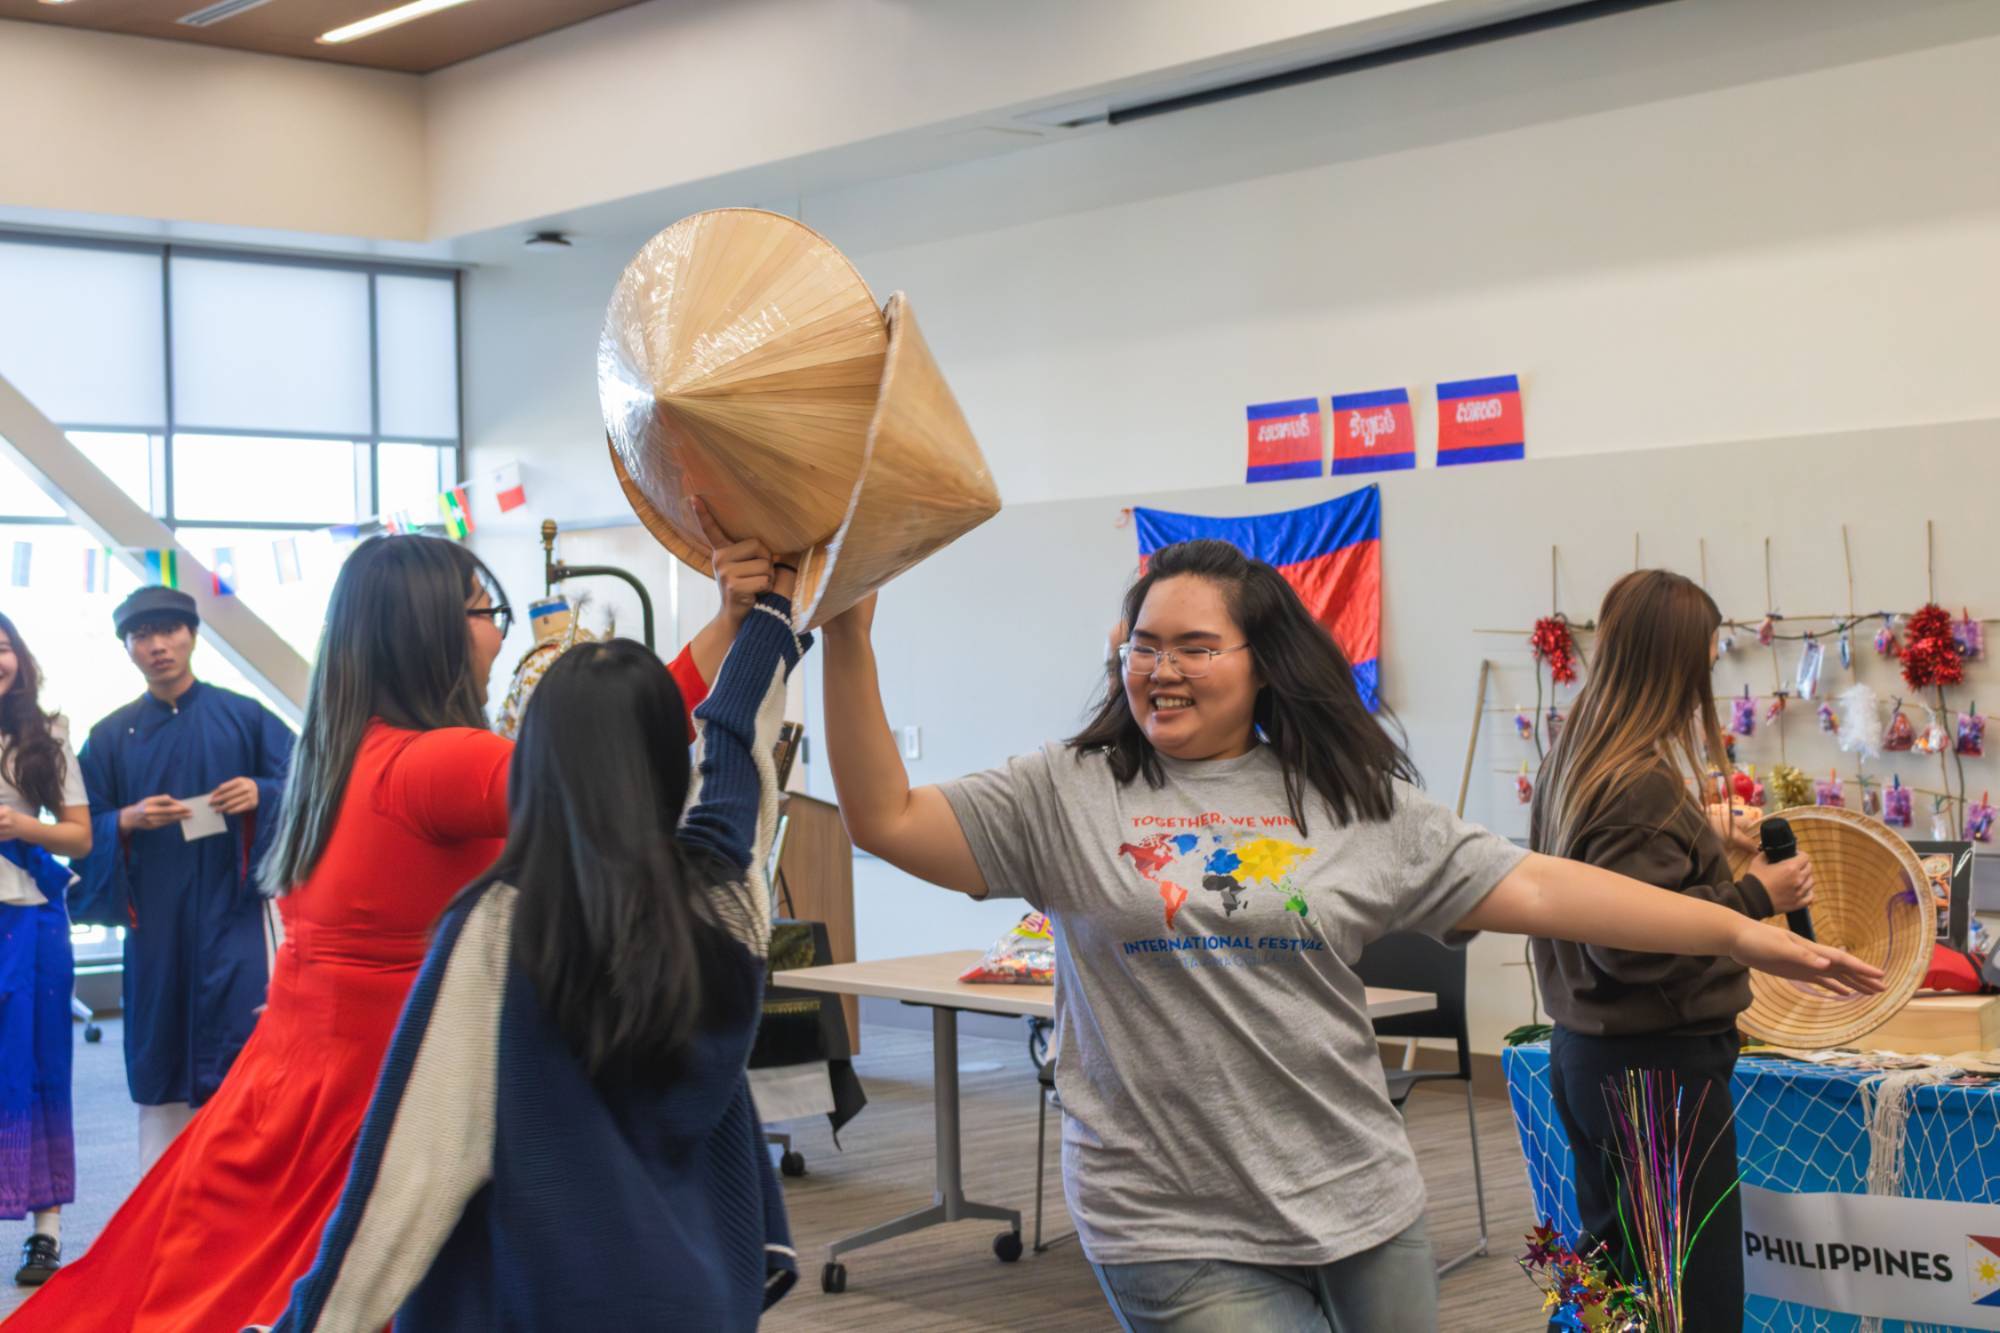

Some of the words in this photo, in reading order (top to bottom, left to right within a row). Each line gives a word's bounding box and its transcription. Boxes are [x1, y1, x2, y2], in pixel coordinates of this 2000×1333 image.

[1230, 814, 1257, 828] WE
[1123, 935, 1253, 955] INTERNATIONAL
[1744, 1231, 1953, 1282] PHILIPPINES
